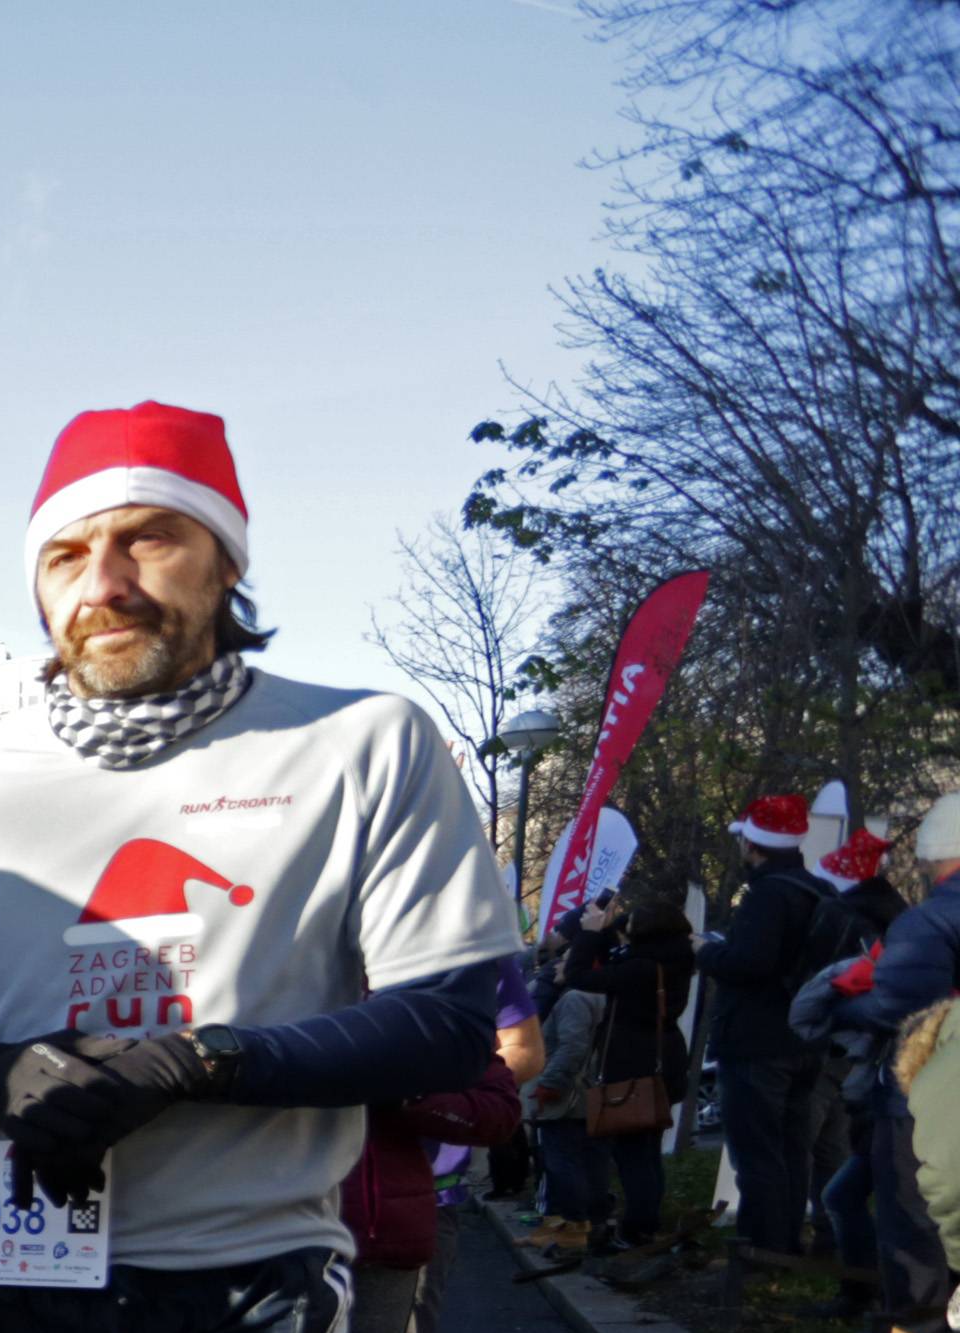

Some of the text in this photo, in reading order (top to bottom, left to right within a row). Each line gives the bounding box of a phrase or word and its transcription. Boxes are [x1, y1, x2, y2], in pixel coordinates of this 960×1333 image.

[179, 795, 293, 815] RUN CROATIA
[69, 944, 196, 974] ZAGREB
[69, 970, 196, 998] ADVENT
[67, 994, 192, 1030] run
